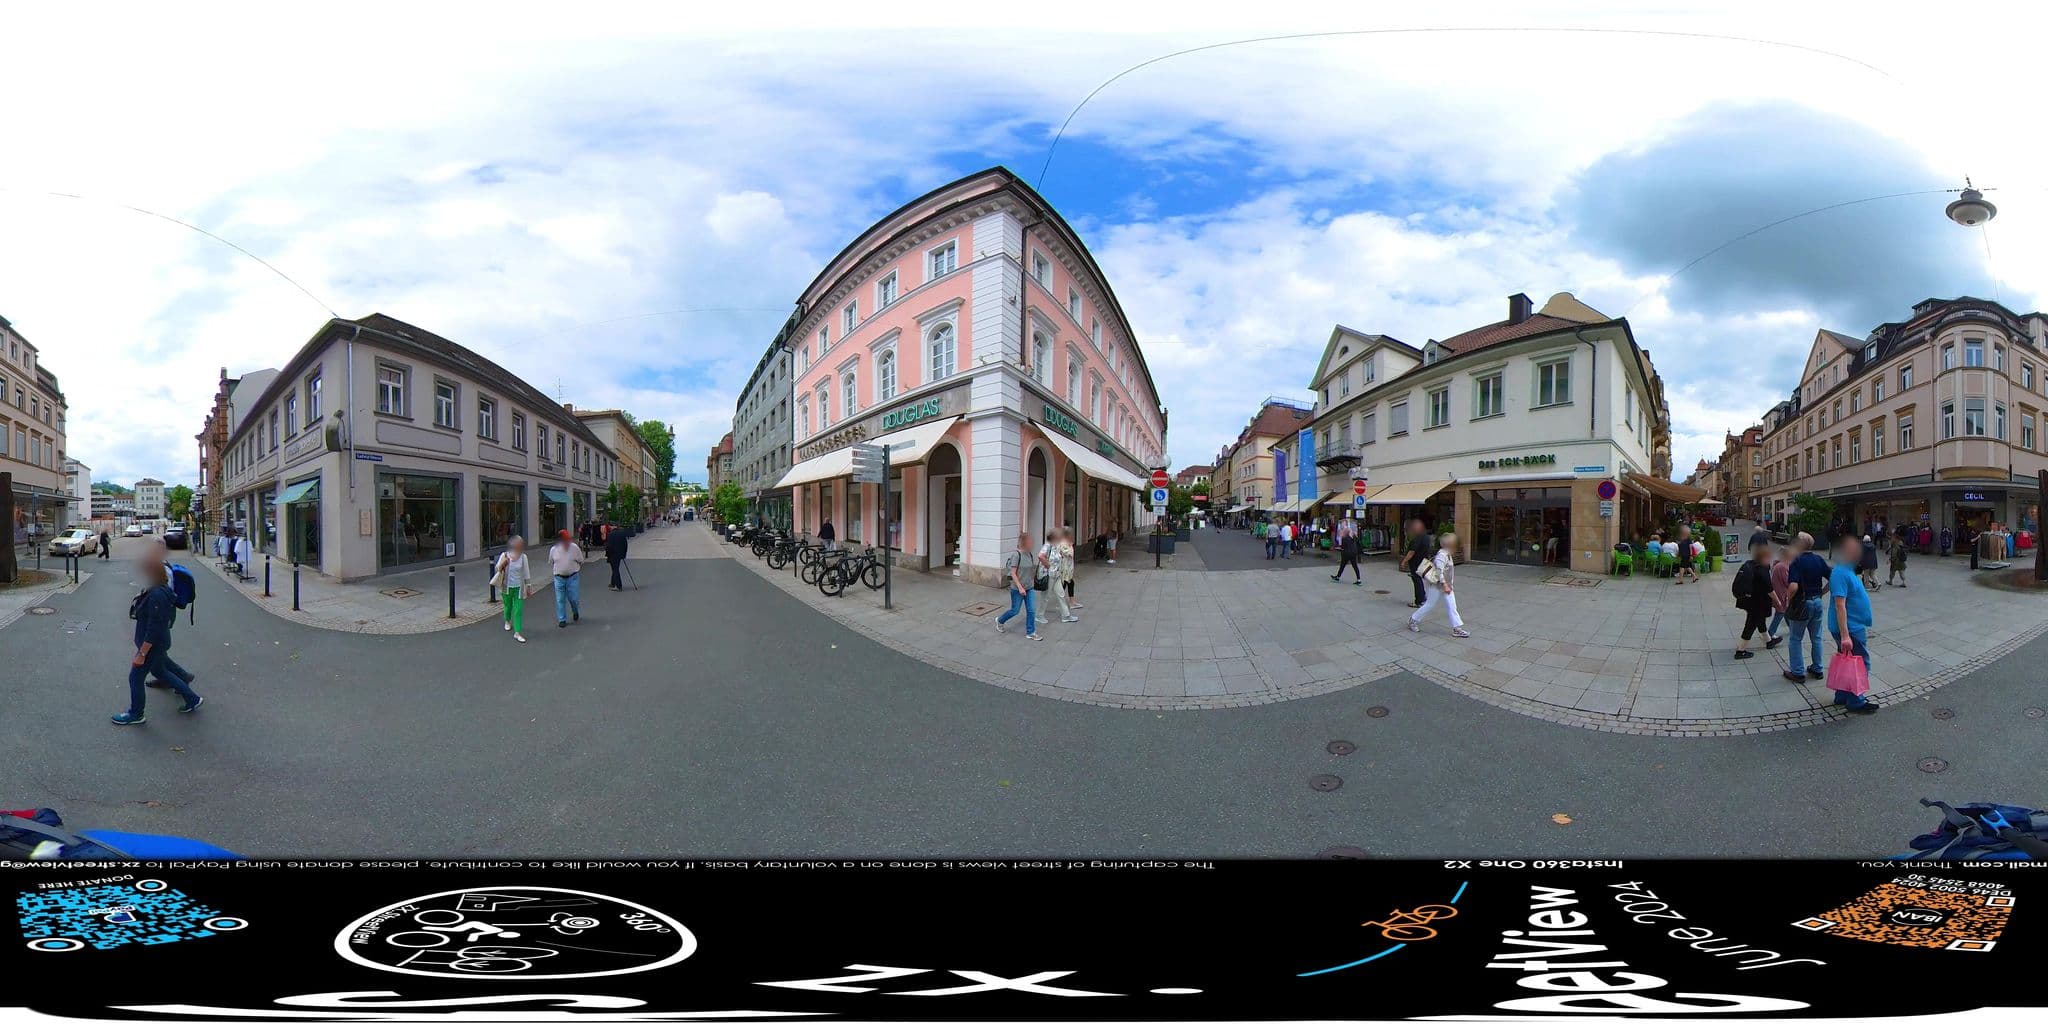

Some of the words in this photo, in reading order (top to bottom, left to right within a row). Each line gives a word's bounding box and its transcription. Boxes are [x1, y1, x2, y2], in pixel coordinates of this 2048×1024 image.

[882, 397, 940, 430] DOUGLAS
[1044, 404, 1078, 437] DOUGLAS
[1478, 460, 1496, 469] DER
[1499, 454, 1555, 467] ECK-BÄCK
